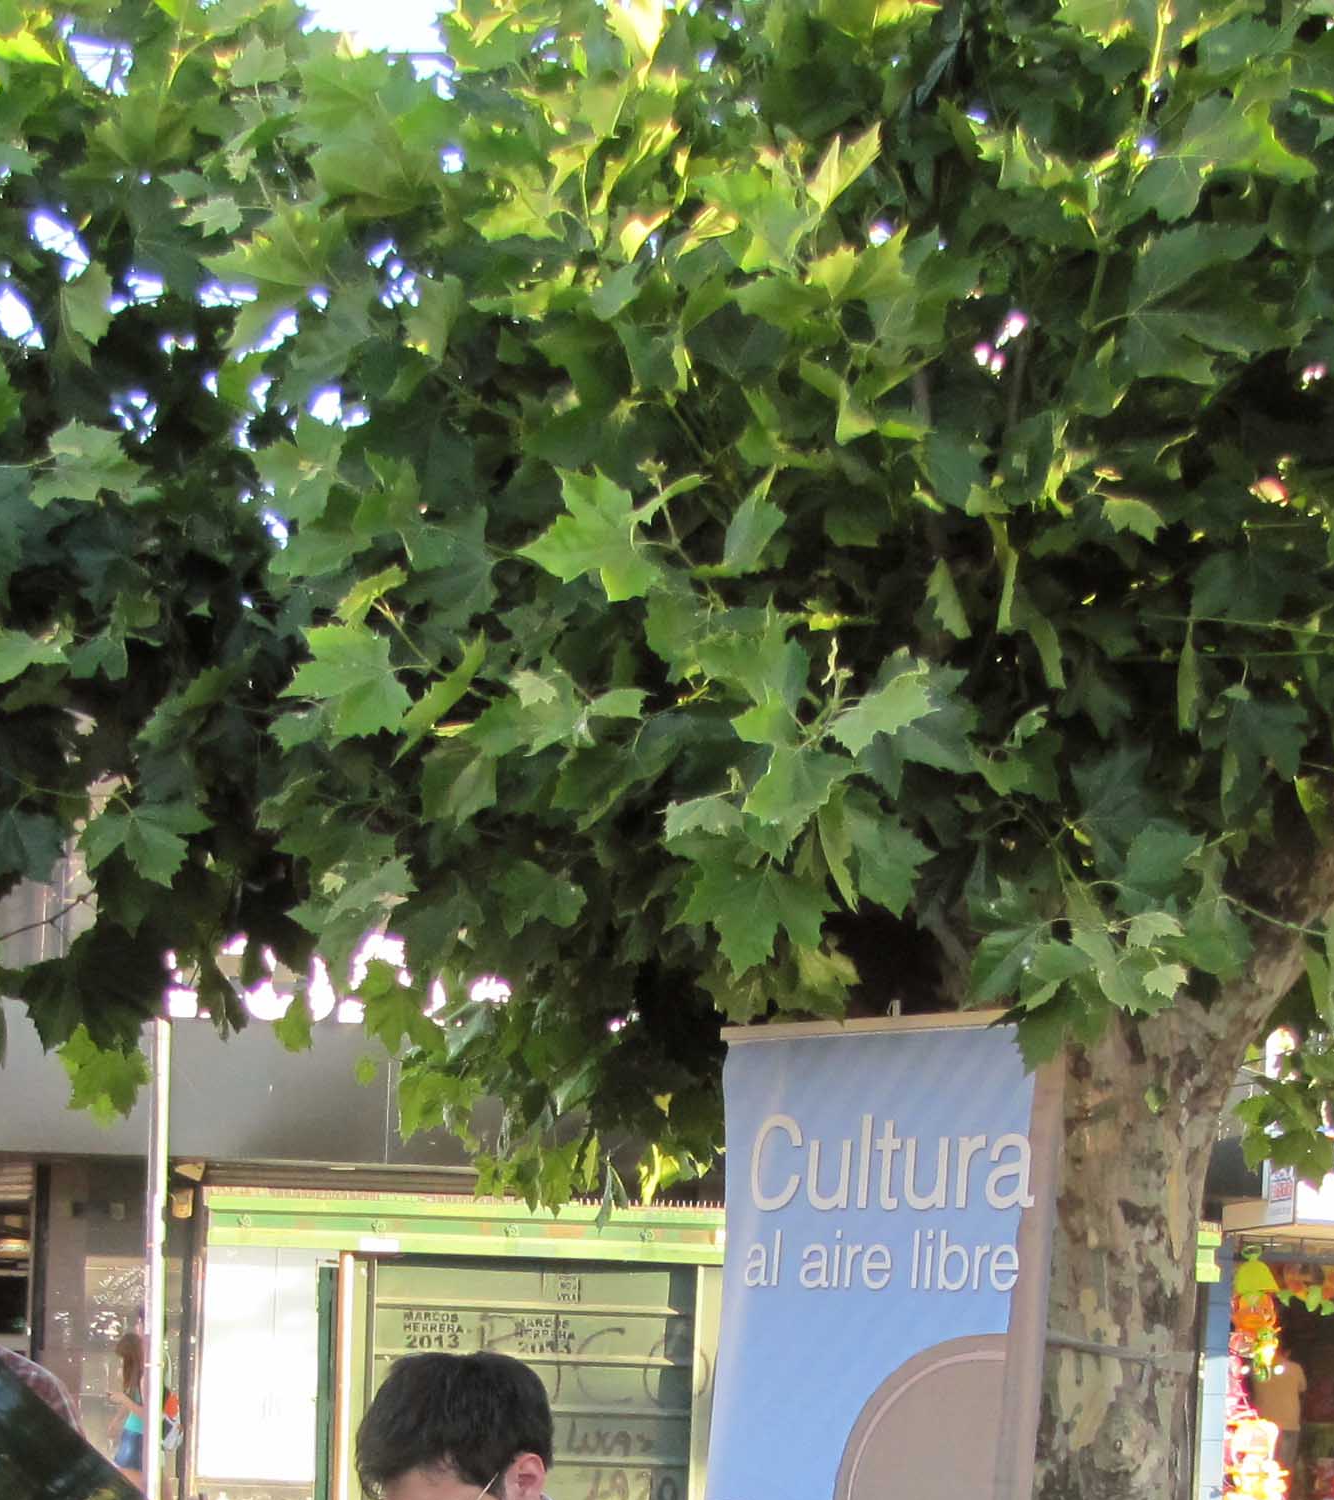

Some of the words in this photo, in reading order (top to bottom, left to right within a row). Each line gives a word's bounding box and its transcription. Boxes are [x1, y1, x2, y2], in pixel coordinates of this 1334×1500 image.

[750, 1113, 1035, 1212] Cultura
[744, 1229, 781, 1288] al
[798, 1230, 892, 1290] aire
[910, 1229, 1020, 1291] libre
[403, 1311, 460, 1322] MARCOS
[404, 1334, 460, 1349] 2013
